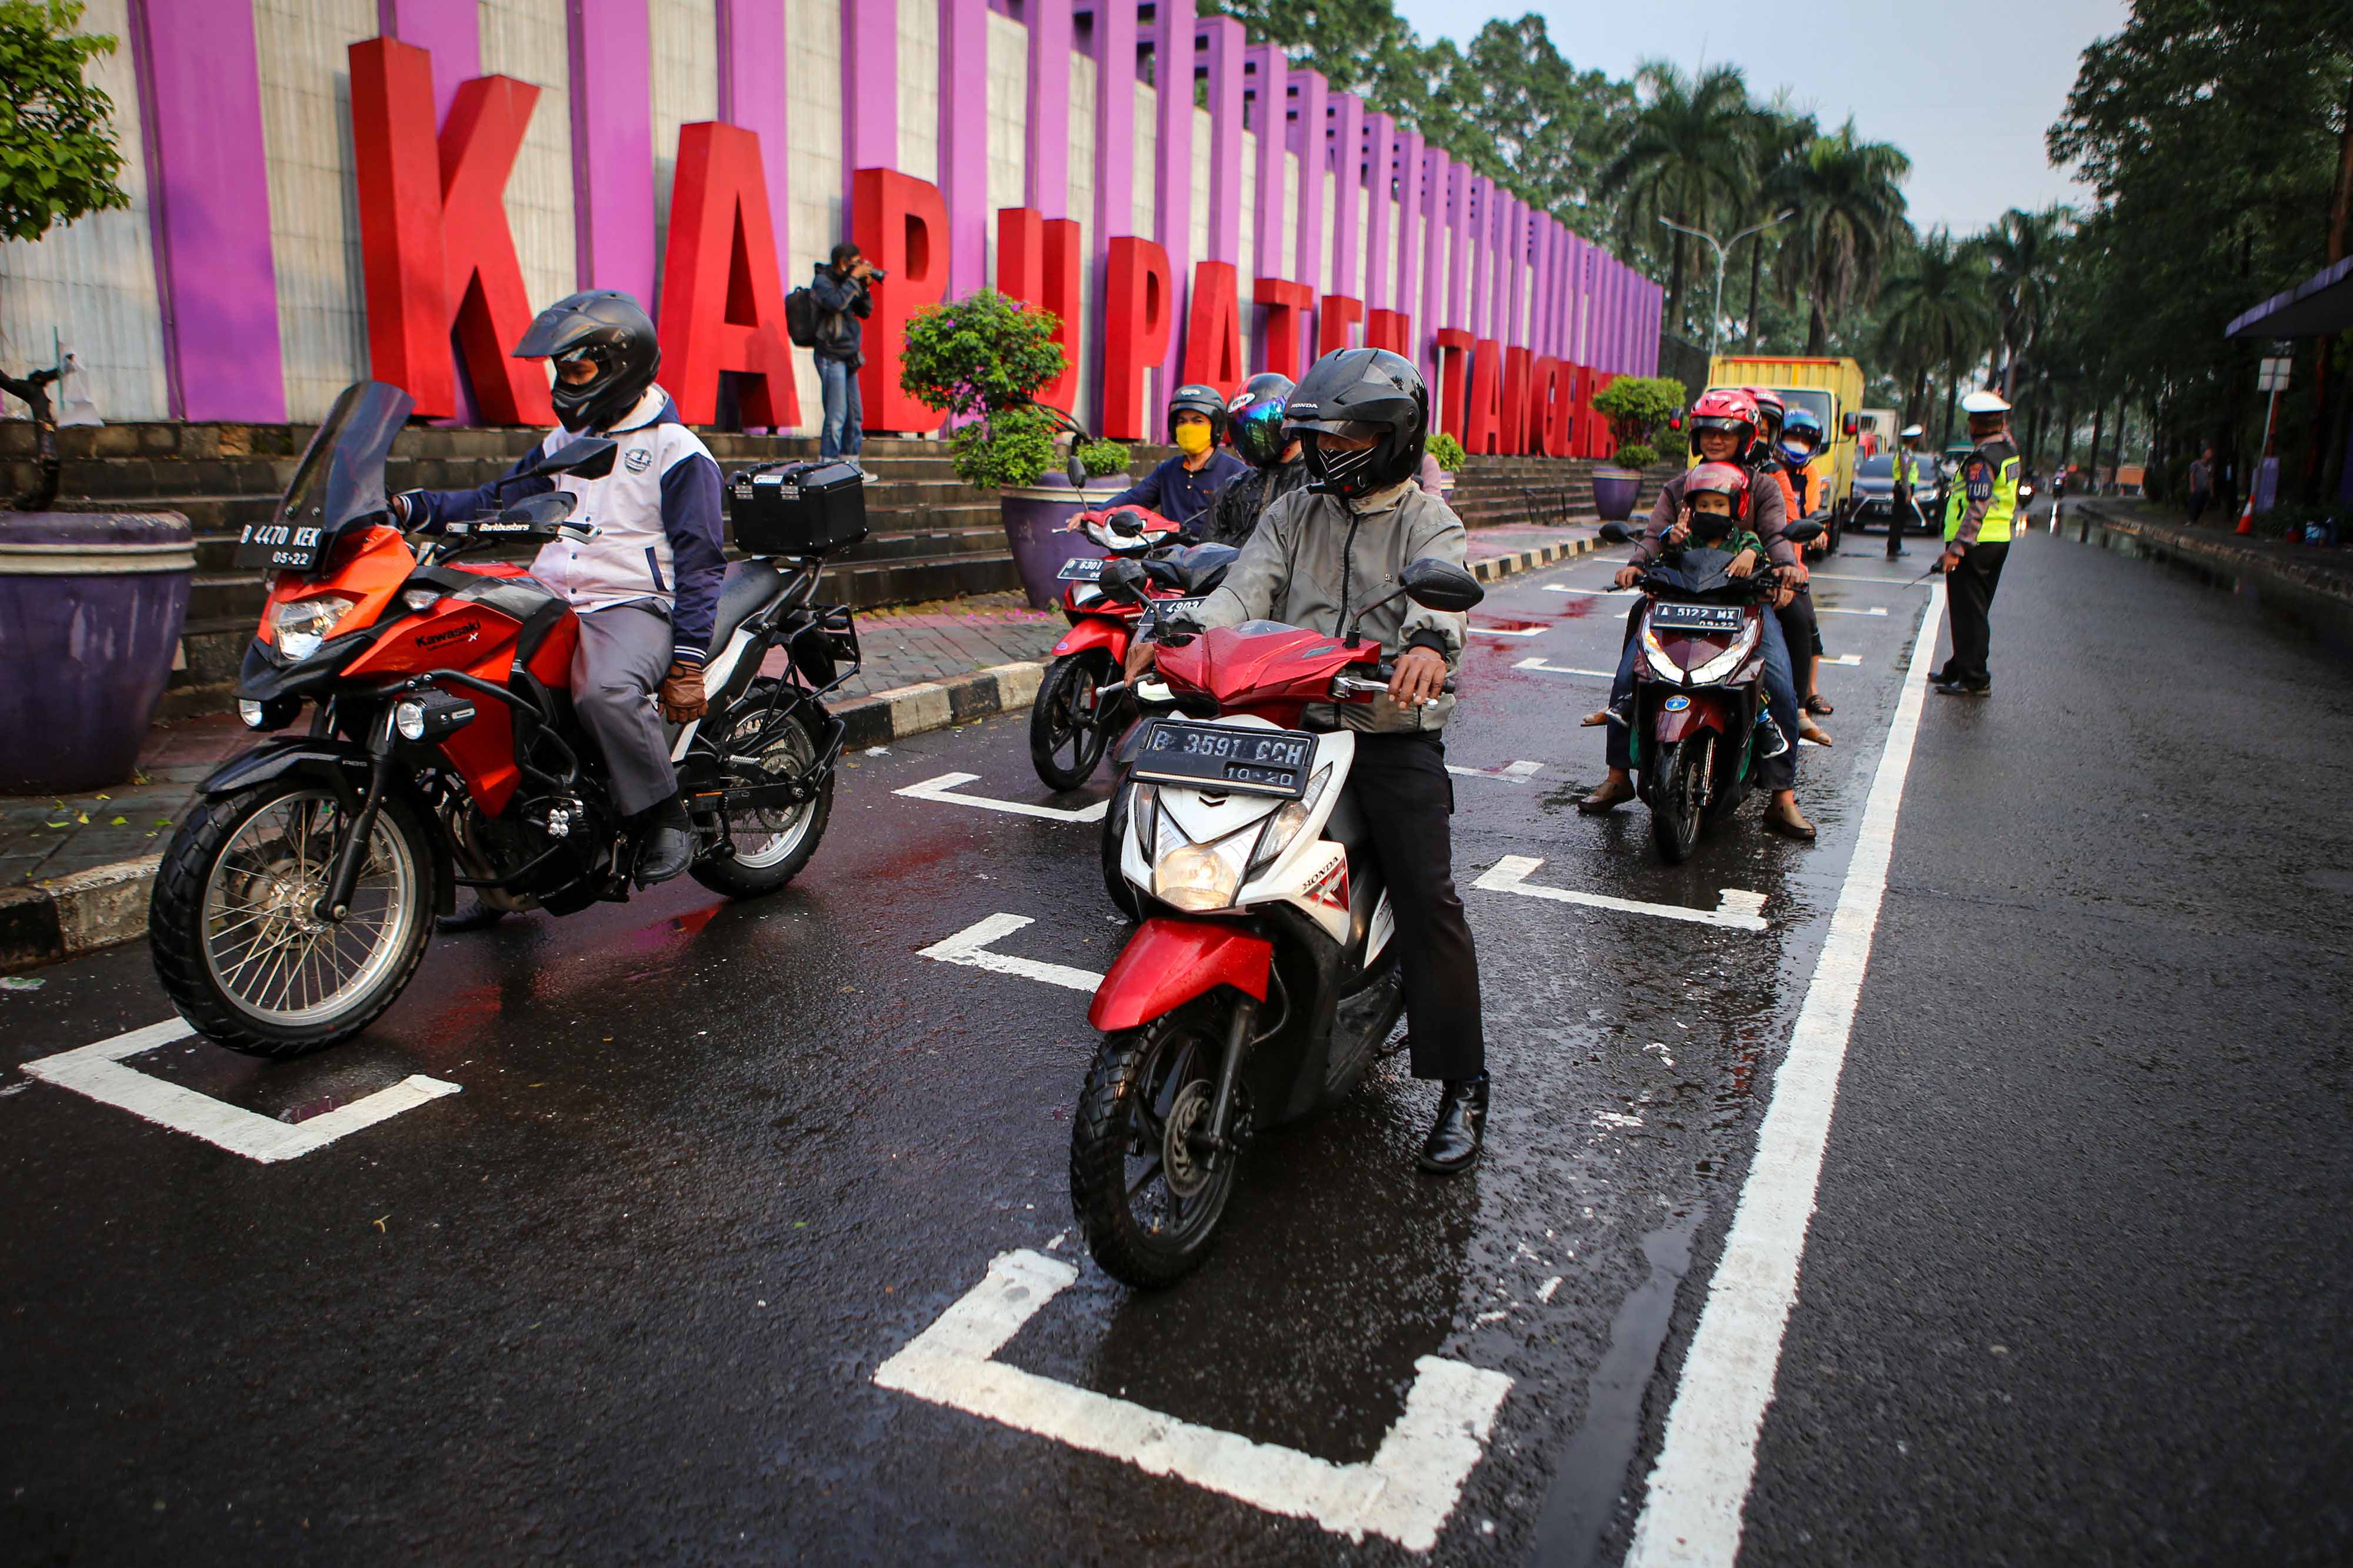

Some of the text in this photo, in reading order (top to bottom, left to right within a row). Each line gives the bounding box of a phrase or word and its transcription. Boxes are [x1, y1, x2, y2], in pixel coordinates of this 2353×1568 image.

[1434, 328, 1631, 459] TANGERA
[240, 523, 322, 548] B 4470 KEK
[1661, 606, 1669, 616] A
[1716, 609, 1735, 619] MX
[415, 619, 481, 648] Kawasaki
[1152, 730, 1168, 751] B
[1183, 733, 1242, 758] 3591
[1302, 856, 1339, 891] HONDA
